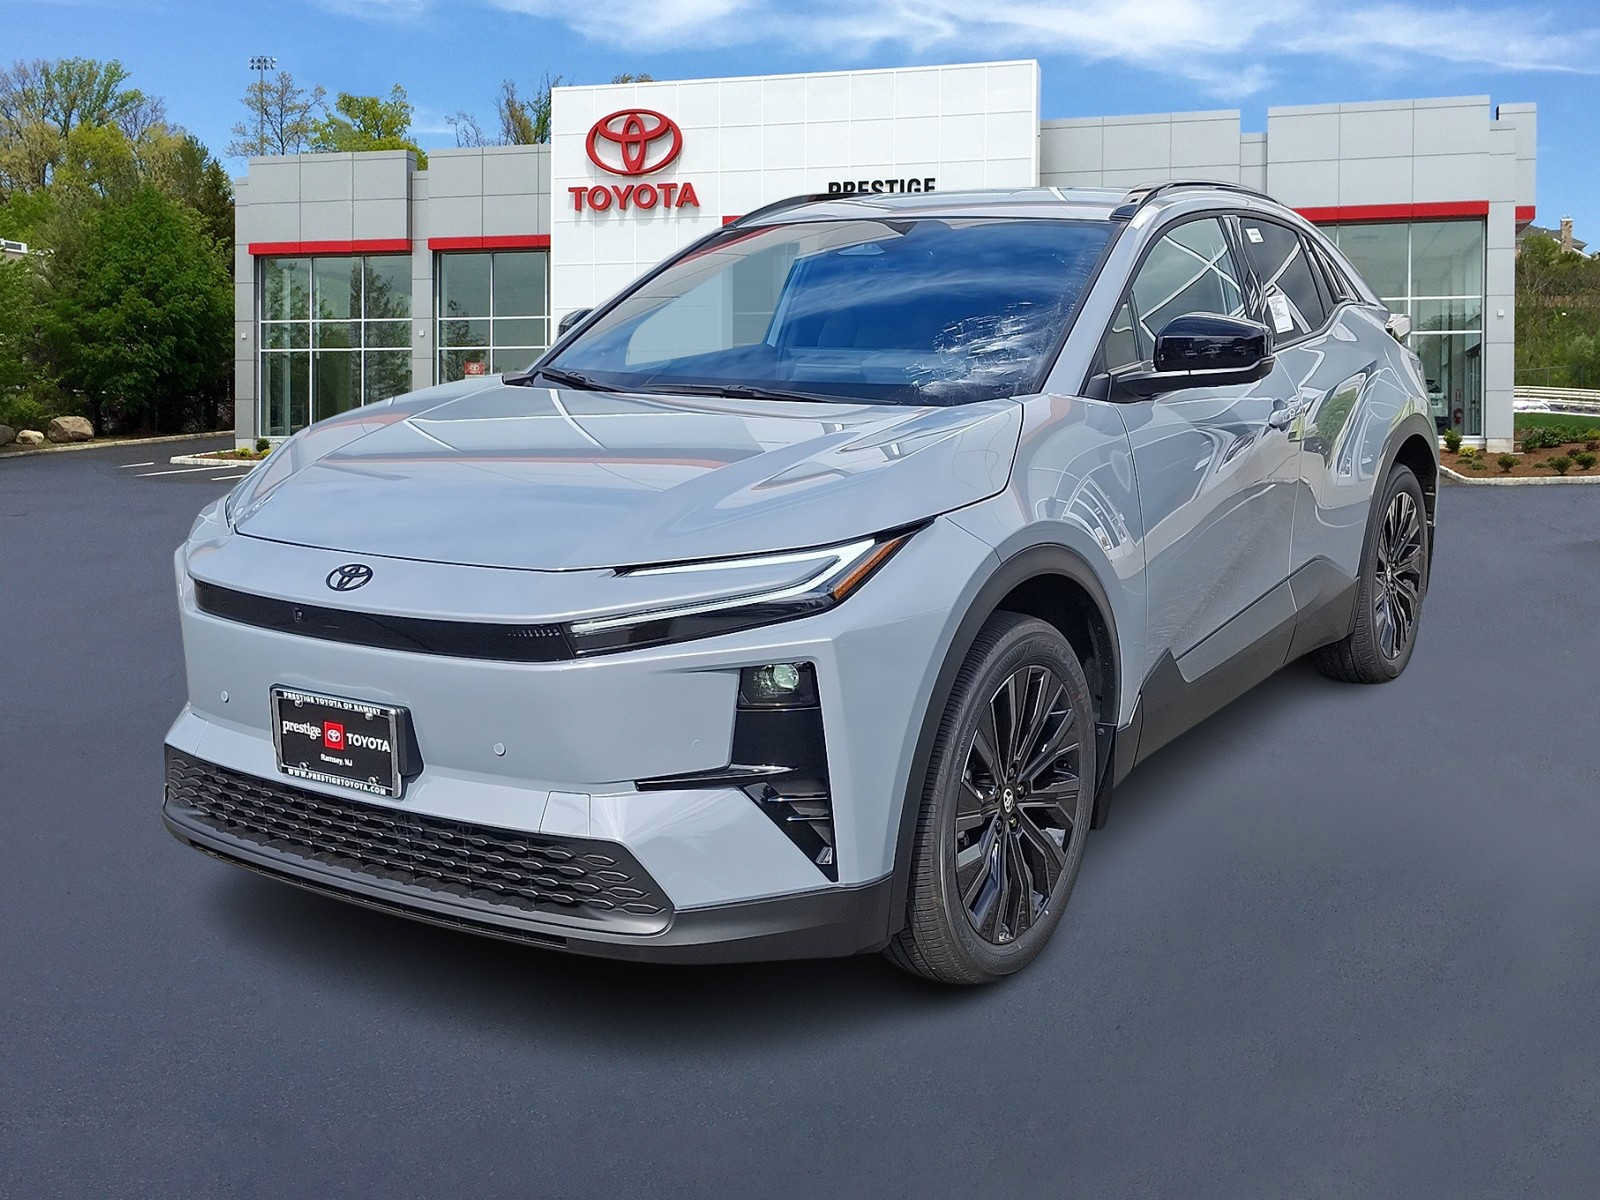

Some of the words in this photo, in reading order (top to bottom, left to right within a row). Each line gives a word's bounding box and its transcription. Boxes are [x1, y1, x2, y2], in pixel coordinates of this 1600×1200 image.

[828, 177, 936, 193] PRESTIGE
[568, 182, 700, 212] TOYOTA
[316, 697, 342, 709] TOYOTA
[282, 720, 322, 740] prestige
[346, 733, 391, 752] TOYOTA
[344, 758, 353, 767] NJ
[287, 768, 386, 795] WWW.PRESTIGETOYOTA.COM
